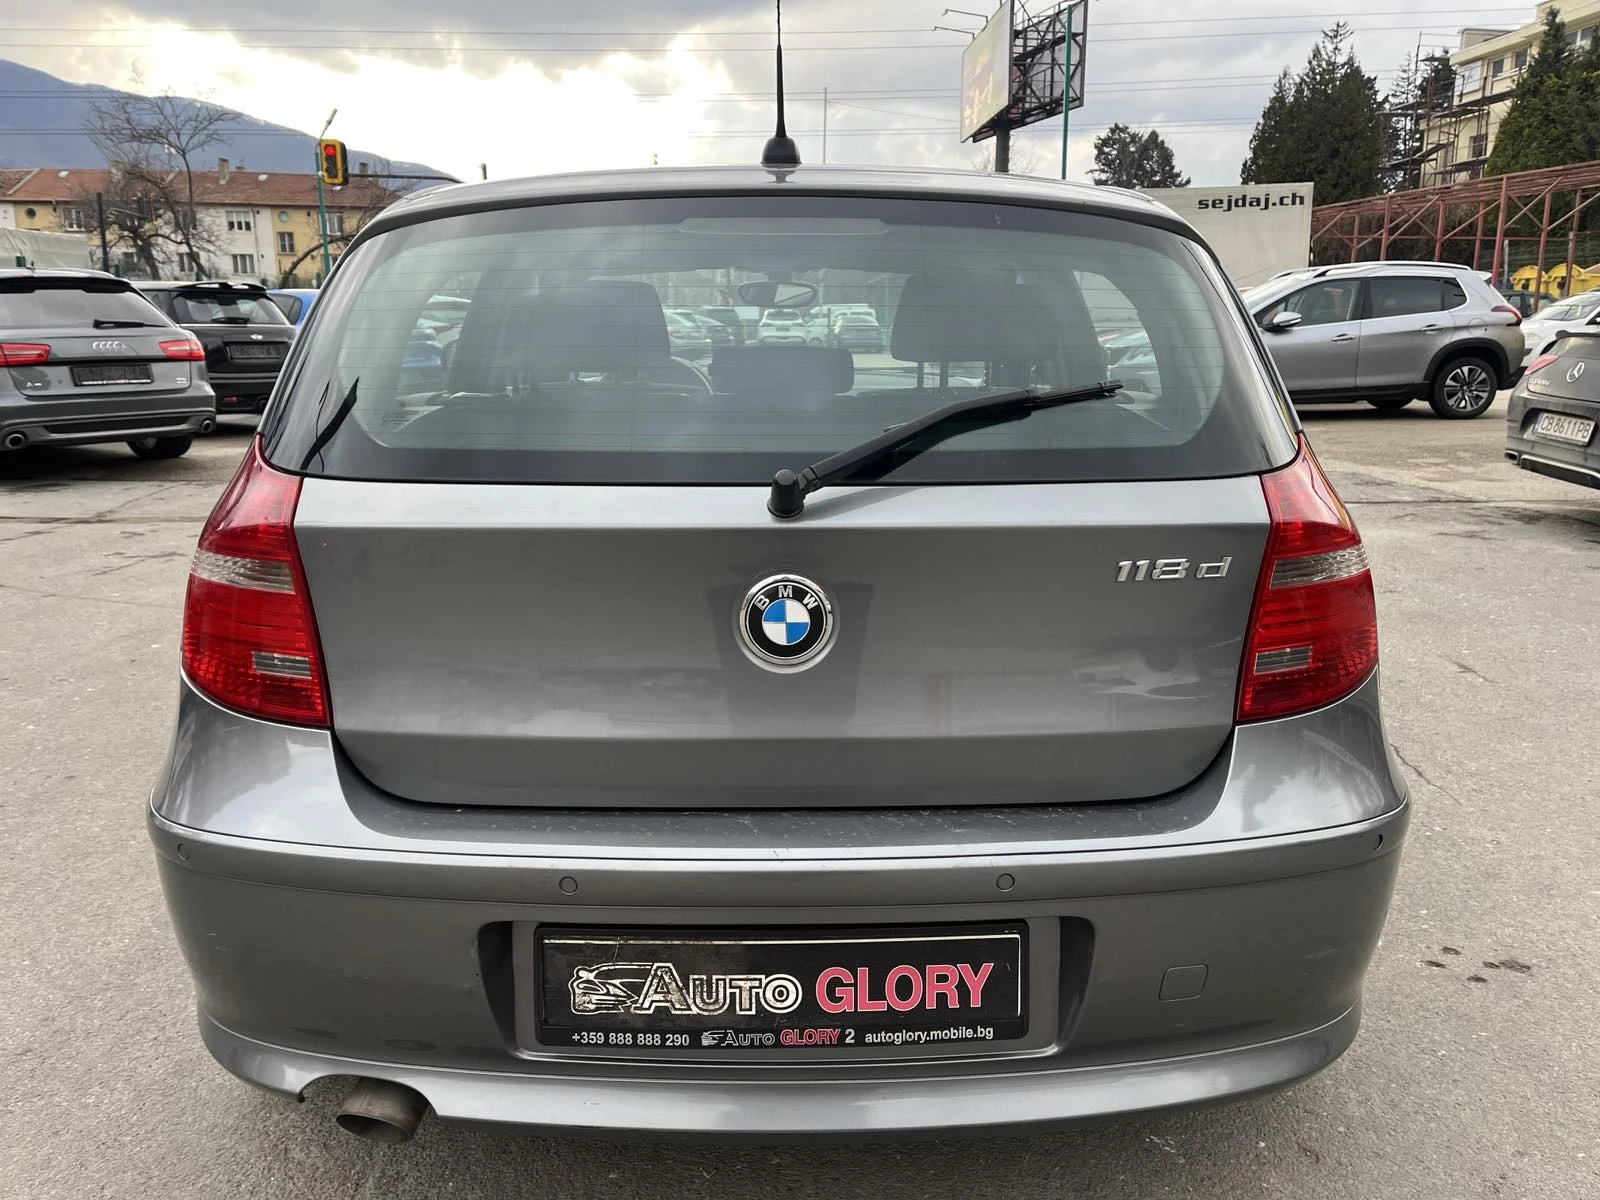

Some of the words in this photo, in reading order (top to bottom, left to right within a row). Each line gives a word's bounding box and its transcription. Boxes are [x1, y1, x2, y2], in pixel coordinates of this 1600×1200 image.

[1197, 192, 1305, 212] sejdaj.ch
[754, 585, 819, 611] BMW
[815, 962, 995, 1014] GLORY
[571, 1031, 604, 1045] +359
[608, 1032, 633, 1046] 888
[636, 1032, 662, 1046] 888
[665, 1033, 690, 1047] 290
[780, 1028, 841, 1046] GLORY
[844, 1028, 856, 1044] 2
[864, 1025, 994, 1045] autoglory.mobile.bg
